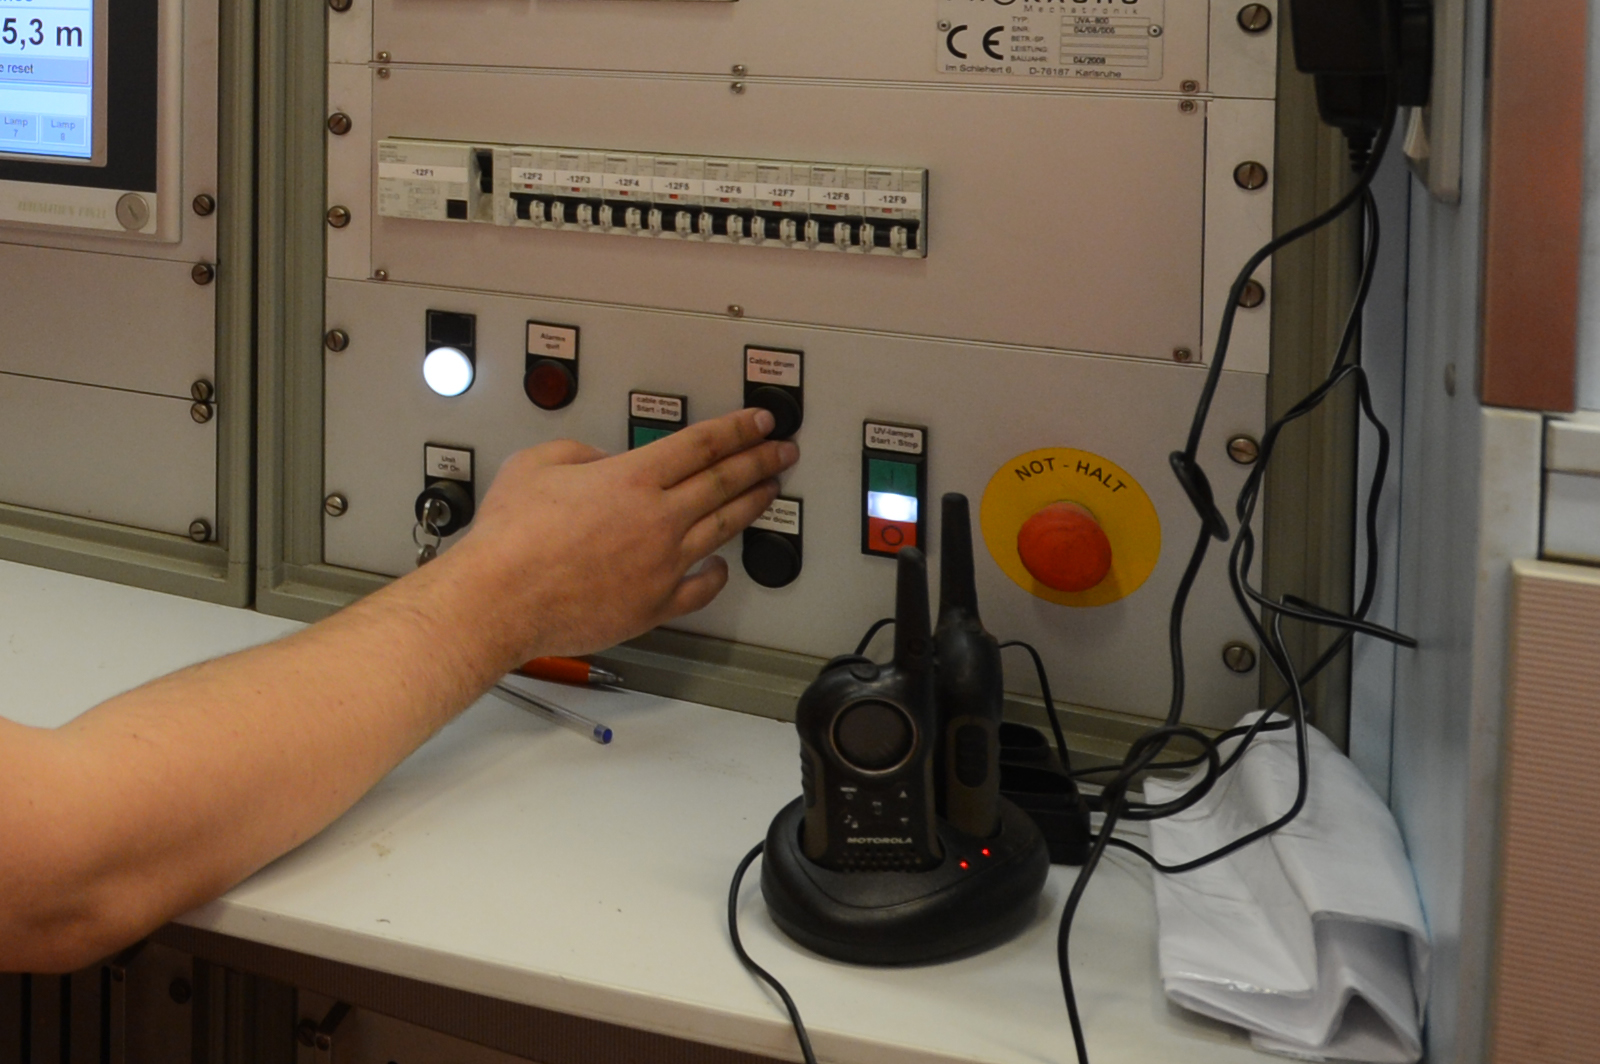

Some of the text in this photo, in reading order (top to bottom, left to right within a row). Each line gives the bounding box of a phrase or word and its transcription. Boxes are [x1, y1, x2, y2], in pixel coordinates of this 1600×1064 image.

[1023, 5, 1139, 14] Mechatronik
[55, 24, 83, 47] m
[7, 62, 34, 74] reset
[1029, 67, 1069, 75] D-76187
[1075, 68, 1122, 78] Karlsruhe
[4, 115, 28, 128] Lamp
[50, 118, 76, 131] Lamp
[519, 172, 543, 181] -12F2
[768, 188, 795, 197] -12F7
[878, 195, 907, 204] -12F9
[870, 435, 890, 445] Start
[898, 439, 918, 449] Stop
[1014, 457, 1056, 481] NOT
[1075, 460, 1127, 493] HALT
[847, 836, 913, 844] MOTOROLA
